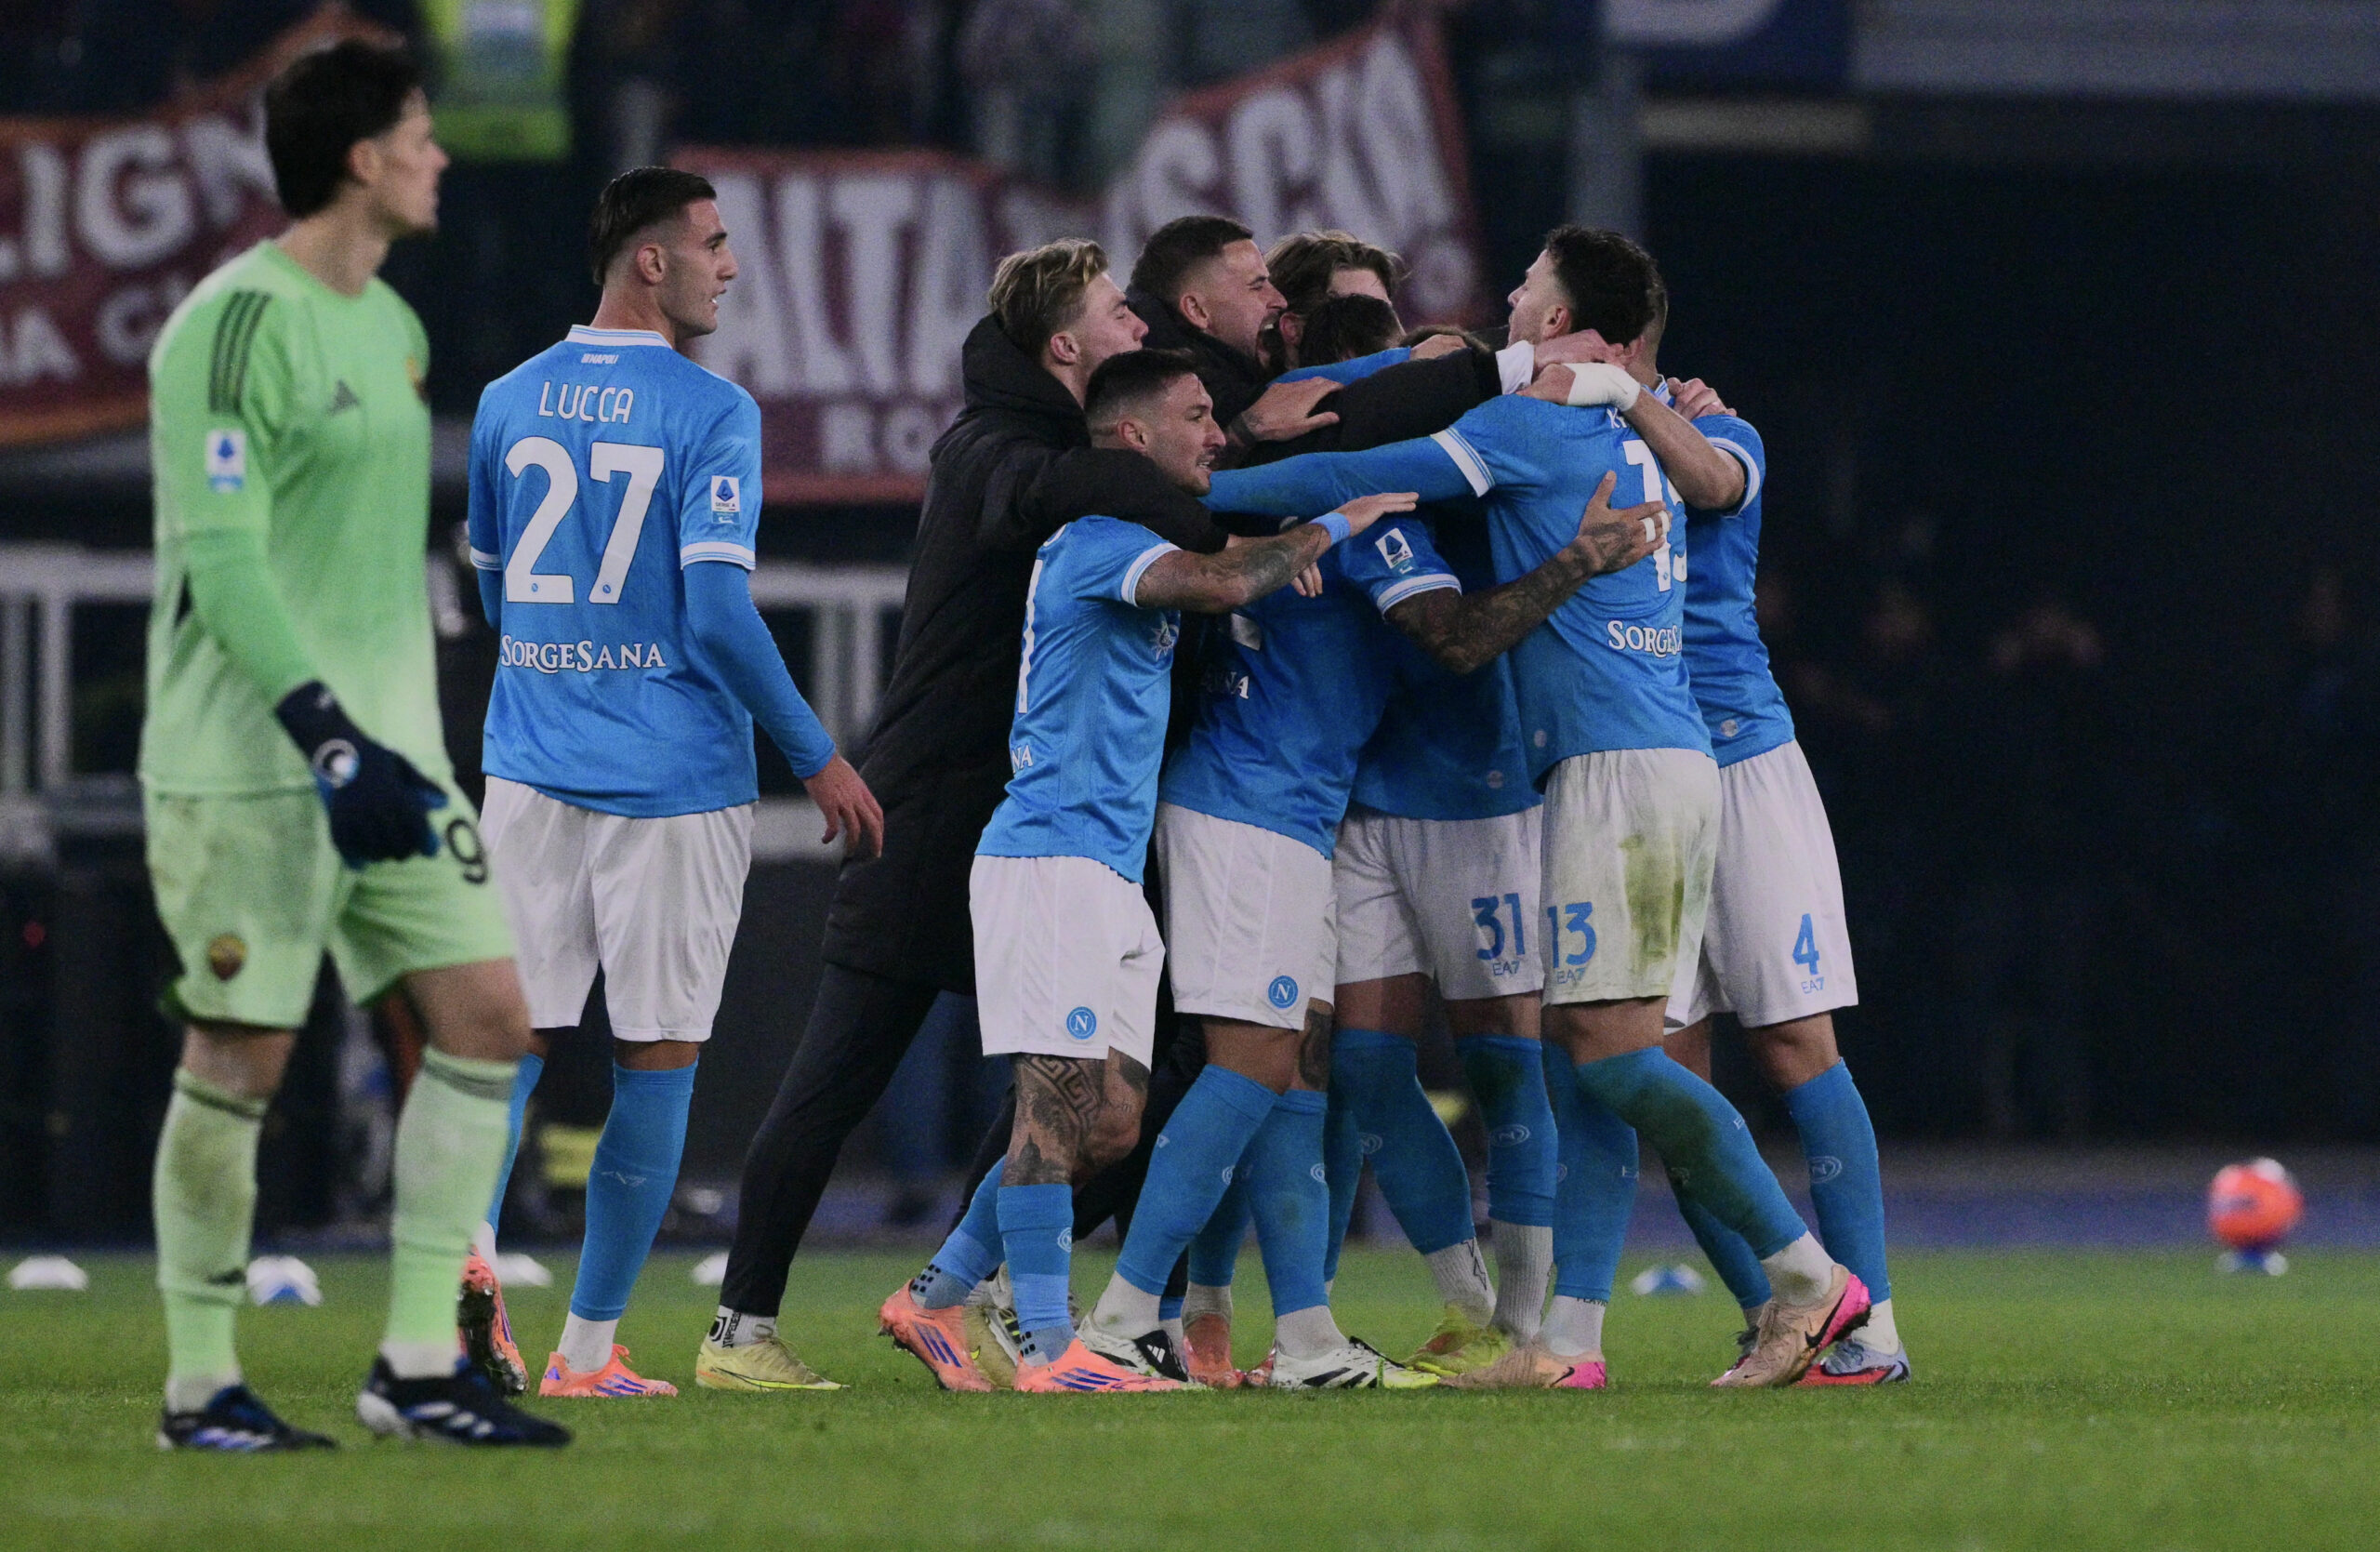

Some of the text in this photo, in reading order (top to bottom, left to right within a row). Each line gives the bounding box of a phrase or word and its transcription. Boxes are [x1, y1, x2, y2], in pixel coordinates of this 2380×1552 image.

[537, 379, 635, 424] LUCCA
[504, 435, 665, 604] 27
[1471, 892, 1526, 960] 31
[1547, 901, 1596, 969] 13
[1792, 913, 1819, 975] 4
[1492, 961, 1520, 976] EA7
[1557, 967, 1586, 984] EA7
[1801, 976, 1825, 994] EA7
